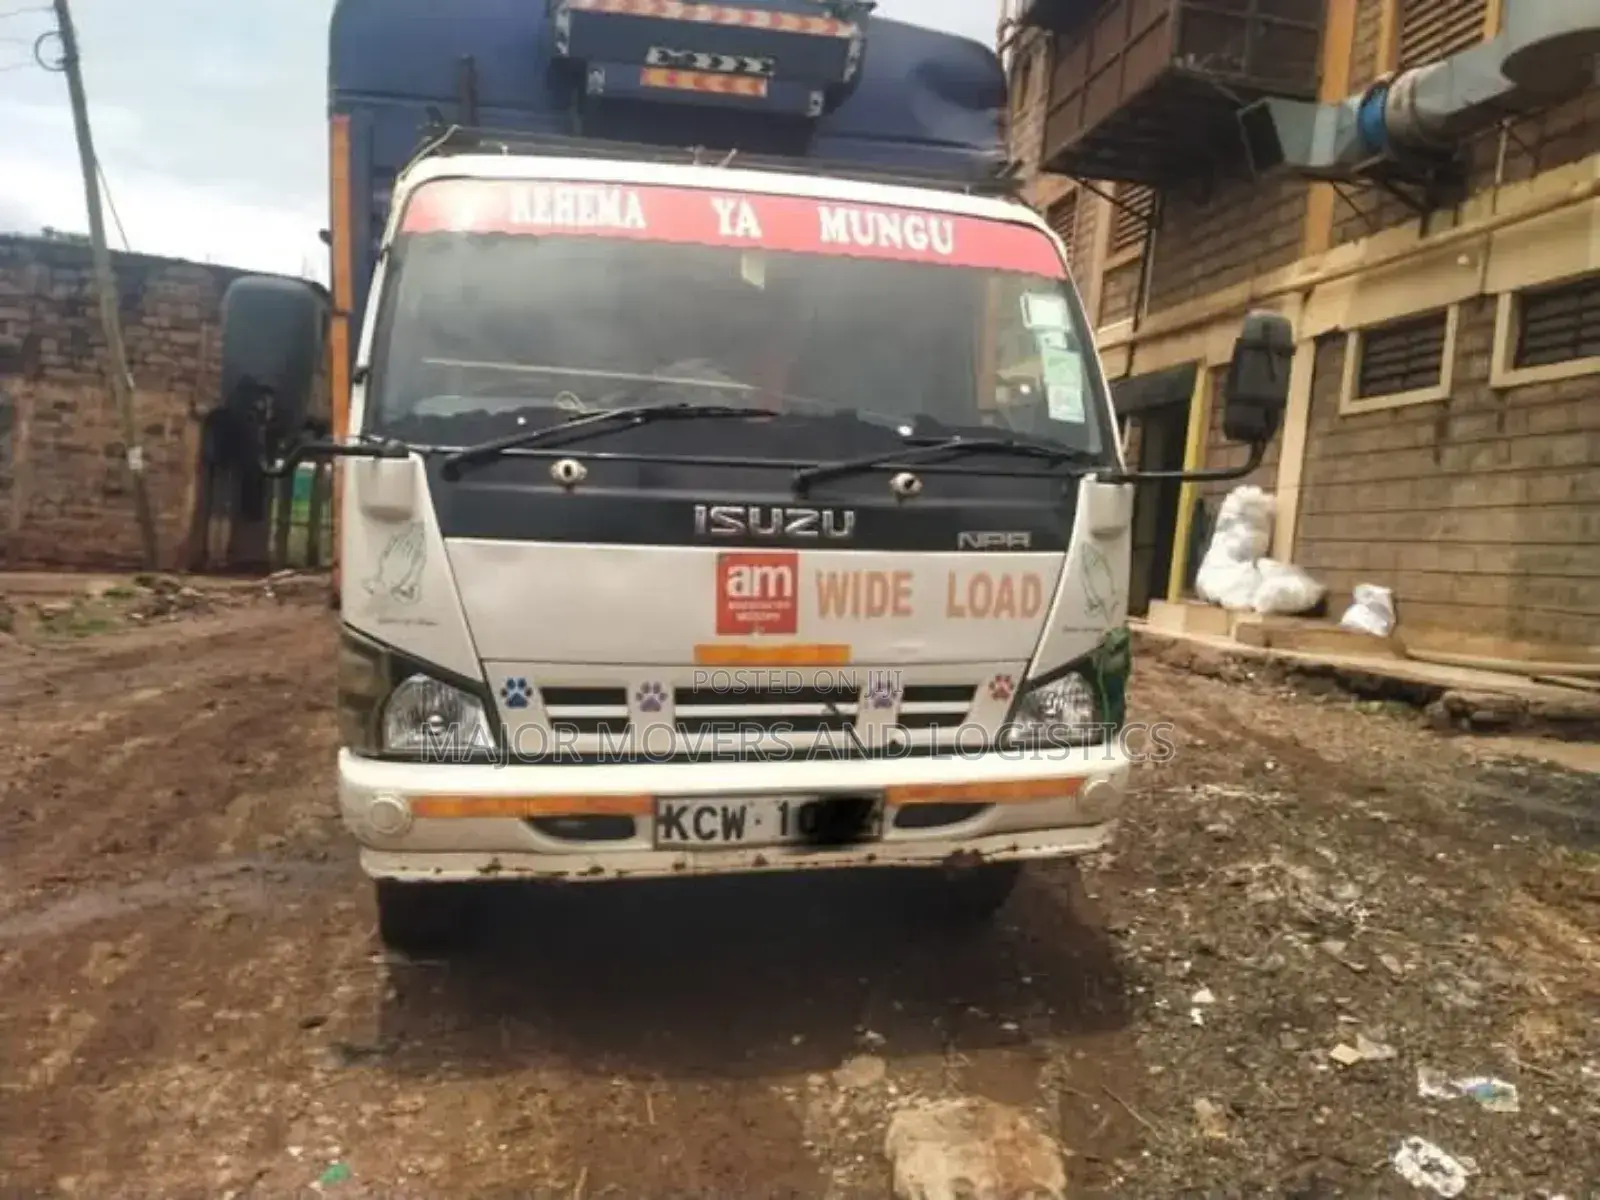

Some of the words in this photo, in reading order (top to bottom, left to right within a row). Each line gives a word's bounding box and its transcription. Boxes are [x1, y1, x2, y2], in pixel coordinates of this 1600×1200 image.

[710, 196, 762, 238] YA
[818, 205, 956, 255] MUNGU
[693, 504, 856, 538] ISUZU
[956, 531, 1033, 550] NPR
[725, 565, 792, 598] am
[815, 569, 915, 619] WIDE
[945, 569, 1043, 620] LOAD
[658, 803, 748, 841] KCW
